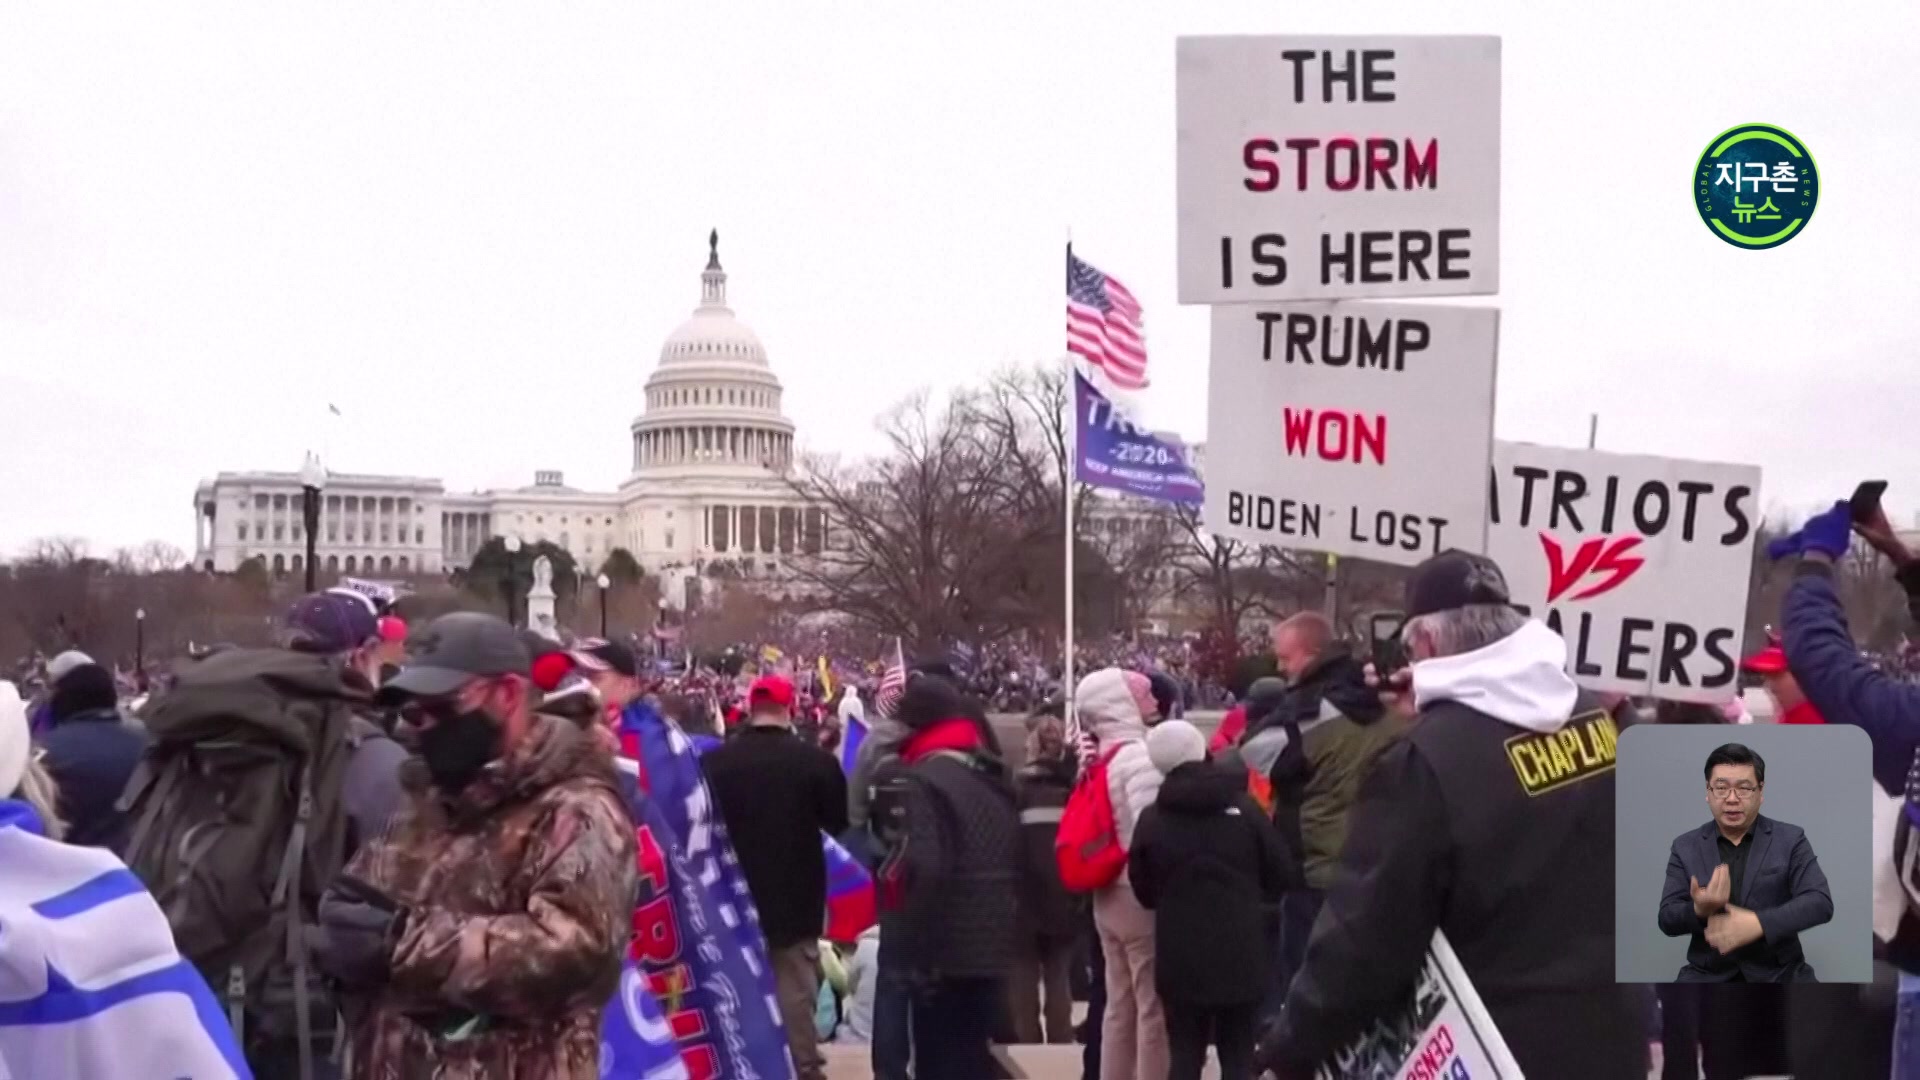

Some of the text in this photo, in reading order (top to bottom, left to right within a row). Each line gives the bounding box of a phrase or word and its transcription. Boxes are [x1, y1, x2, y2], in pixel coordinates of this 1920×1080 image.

[1281, 49, 1395, 103] THE
[1243, 137, 1439, 192] STORM
[1221, 229, 1471, 288] IS HERE
[1256, 312, 1430, 371] TRUMP
[1283, 406, 1387, 466] WON
[1228, 490, 1449, 554] BIDEN LOST
[1537, 530, 1646, 604] VS
